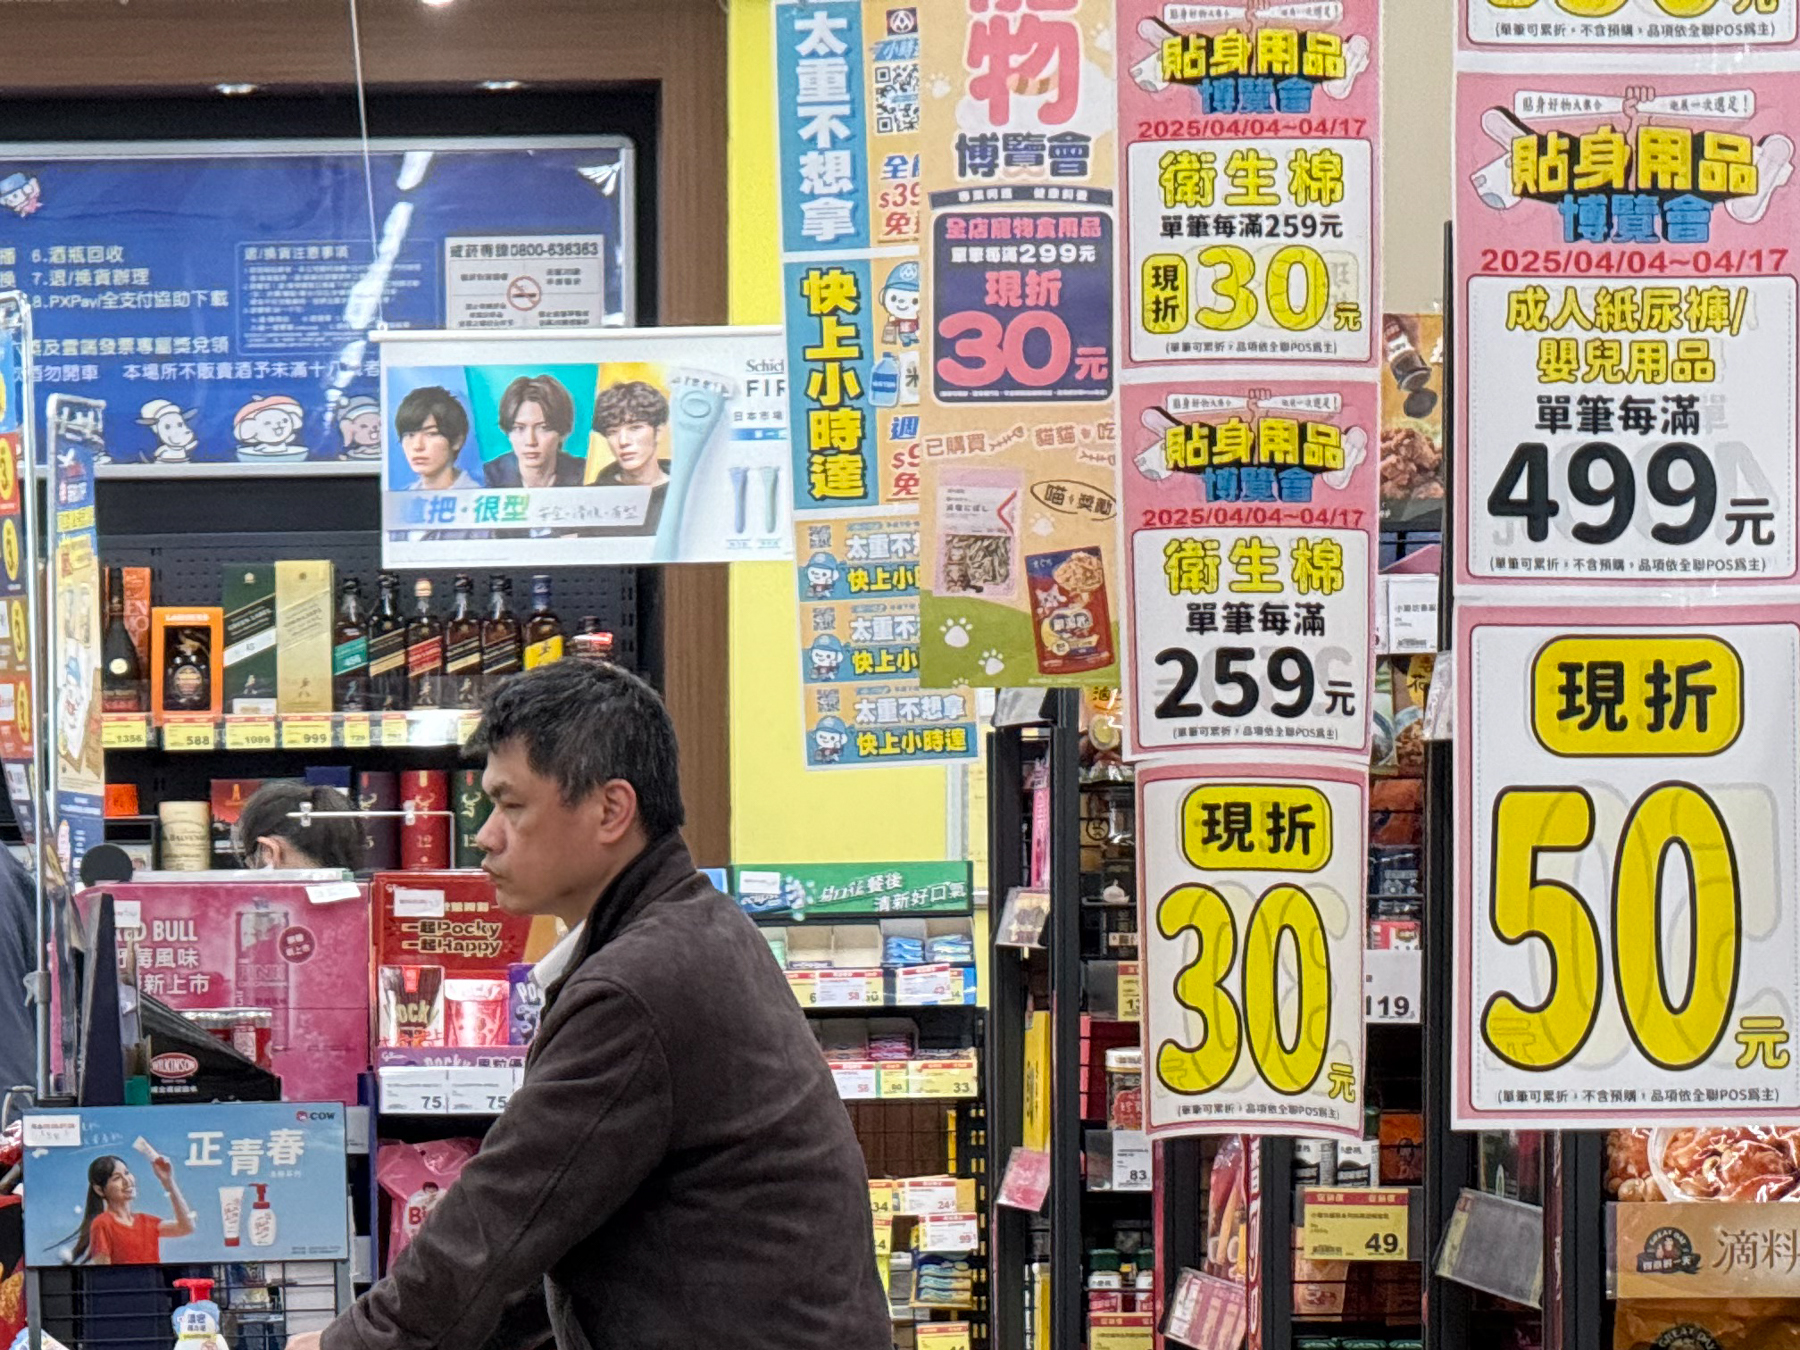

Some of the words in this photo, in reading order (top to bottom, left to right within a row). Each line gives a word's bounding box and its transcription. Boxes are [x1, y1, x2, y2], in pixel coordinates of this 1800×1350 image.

[1161, 27, 1347, 82] 貼身用品
[794, 10, 857, 242] 太重不想拿
[1138, 118, 1366, 139] 2025/04/04~04/17
[955, 131, 1091, 179] 博覽會
[1511, 124, 1759, 197] 貼身用品
[1158, 148, 1343, 208] 衛生棉
[1159, 213, 1343, 239] 單筆每滿259元
[1558, 193, 1715, 244] 博覽會
[1480, 248, 1789, 274] 2025/04/04~04/17
[985, 269, 1062, 307] 現折
[1151, 264, 1179, 323] 現折
[1505, 285, 1748, 337] 成人紙尿褲/
[1537, 338, 1716, 384] 嬰兒用品
[801, 266, 868, 501] 快上小時達
[1535, 394, 1700, 435] 單筆每滿
[1165, 416, 1345, 471] 貼身用品
[1142, 507, 1364, 528] 2025/04/04~04/17
[1163, 535, 1345, 596] 衛生棉
[1185, 601, 1326, 637] 單筆每滿
[855, 693, 967, 723] 太重不想拿
[1555, 659, 1718, 734] 現折
[857, 726, 967, 757] 快上小時達
[1200, 801, 1316, 855] 現折
[153, 922, 198, 942] BULL
[310, 1111, 336, 1121] COW
[420, 1095, 442, 1110] 75
[487, 1095, 508, 1110] 75
[184, 1127, 306, 1177] 正青春
[1129, 1169, 1147, 1181] 83
[1365, 1233, 1398, 1253] 49
